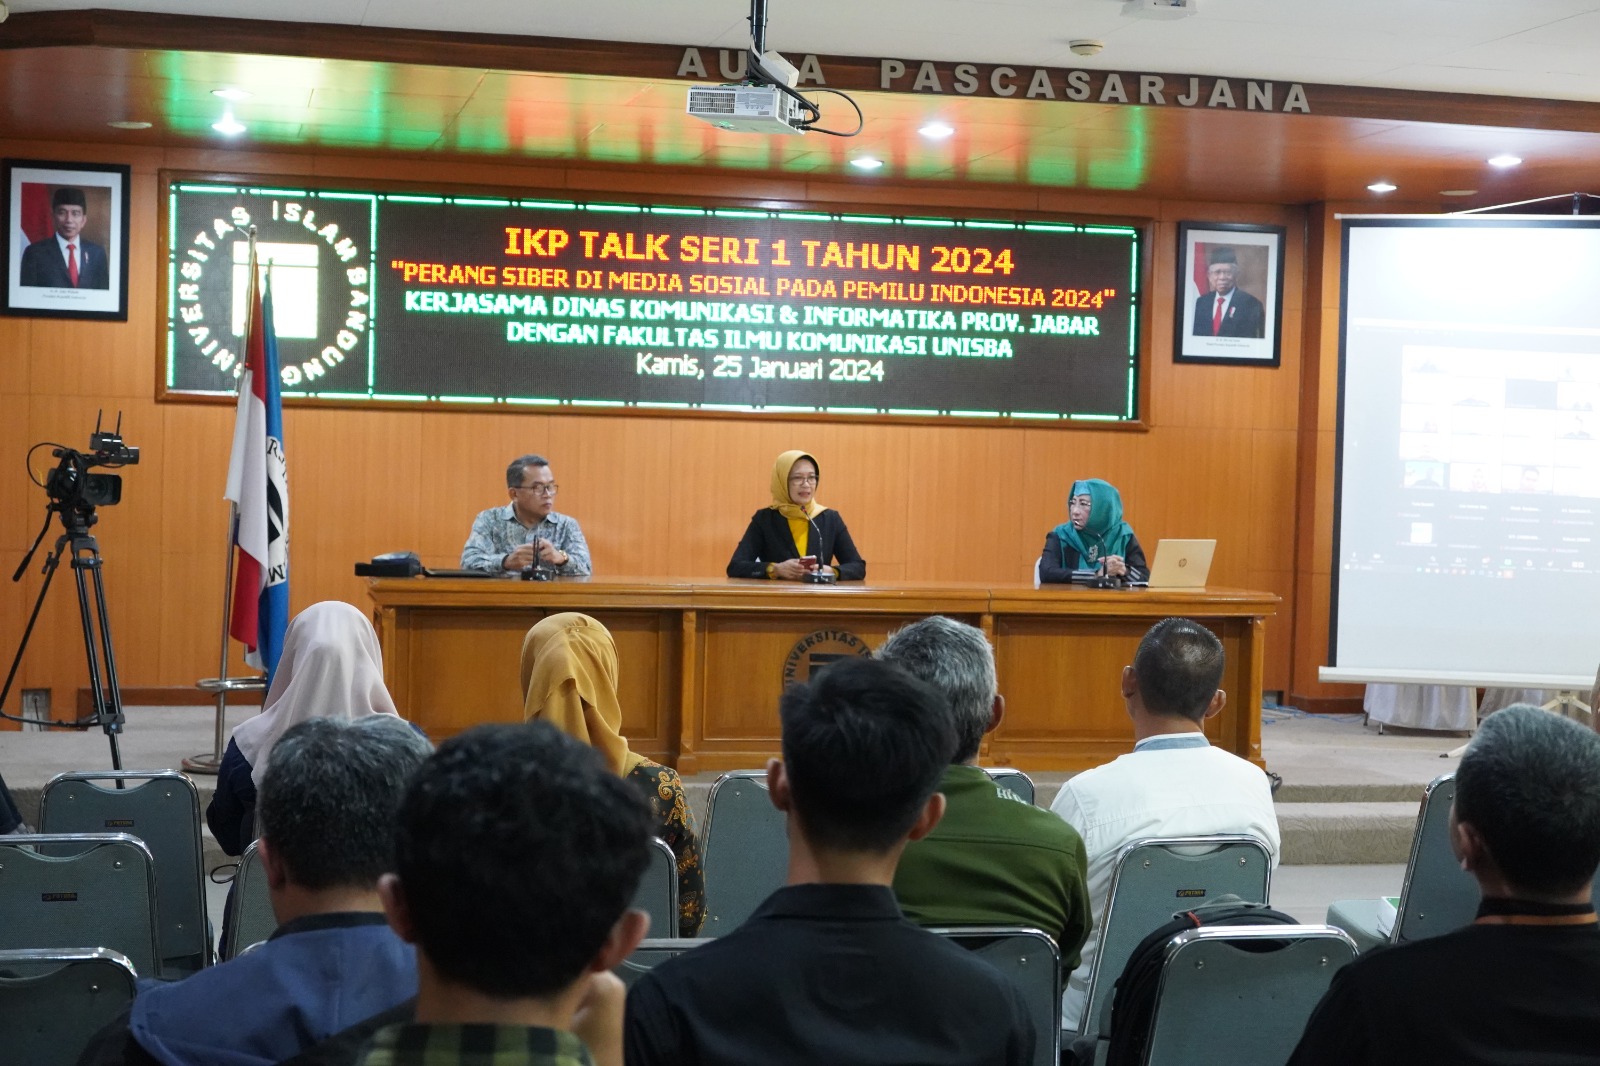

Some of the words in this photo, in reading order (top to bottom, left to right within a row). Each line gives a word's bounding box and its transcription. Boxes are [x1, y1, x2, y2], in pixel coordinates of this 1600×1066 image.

[677, 47, 826, 85] AUA
[881, 59, 1311, 114] PASCASARJANA
[272, 200, 358, 262] ISLAM
[504, 226, 569, 257] IKP
[579, 230, 670, 261] TALK
[679, 234, 760, 265] SERI
[771, 239, 791, 266] 1
[801, 240, 920, 272] TAHUN
[930, 246, 1015, 275] 2024
[391, 260, 496, 285] "PERANG
[502, 266, 570, 288] SIBER
[576, 269, 602, 290] DI
[608, 271, 684, 293] MEDIA
[689, 274, 771, 296] SOSIAL
[776, 277, 837, 299] PADA
[843, 280, 925, 302] PEMILU
[930, 284, 1046, 306] INDONESIA
[1051, 288, 1115, 309] 2024"
[281, 267, 369, 386] BANDUNG
[405, 290, 547, 316] KERJASAMA
[553, 296, 625, 320] DINAS
[630, 298, 775, 324] KOMUNIKASI
[779, 304, 799, 324] &
[803, 306, 957, 331] INFORMATIKA
[962, 311, 1025, 333] PROV.
[1029, 314, 1100, 336] JABAR
[506, 321, 598, 346] DENGAN
[603, 325, 719, 349] FAKULTAS
[723, 329, 783, 351] ILMU
[787, 331, 928, 356] KOMUNIKASI
[932, 337, 1013, 359] UNISBA
[636, 352, 705, 380] Kamis,
[713, 355, 742, 378] 25
[748, 356, 823, 382] Januari
[829, 359, 885, 382] 2024
